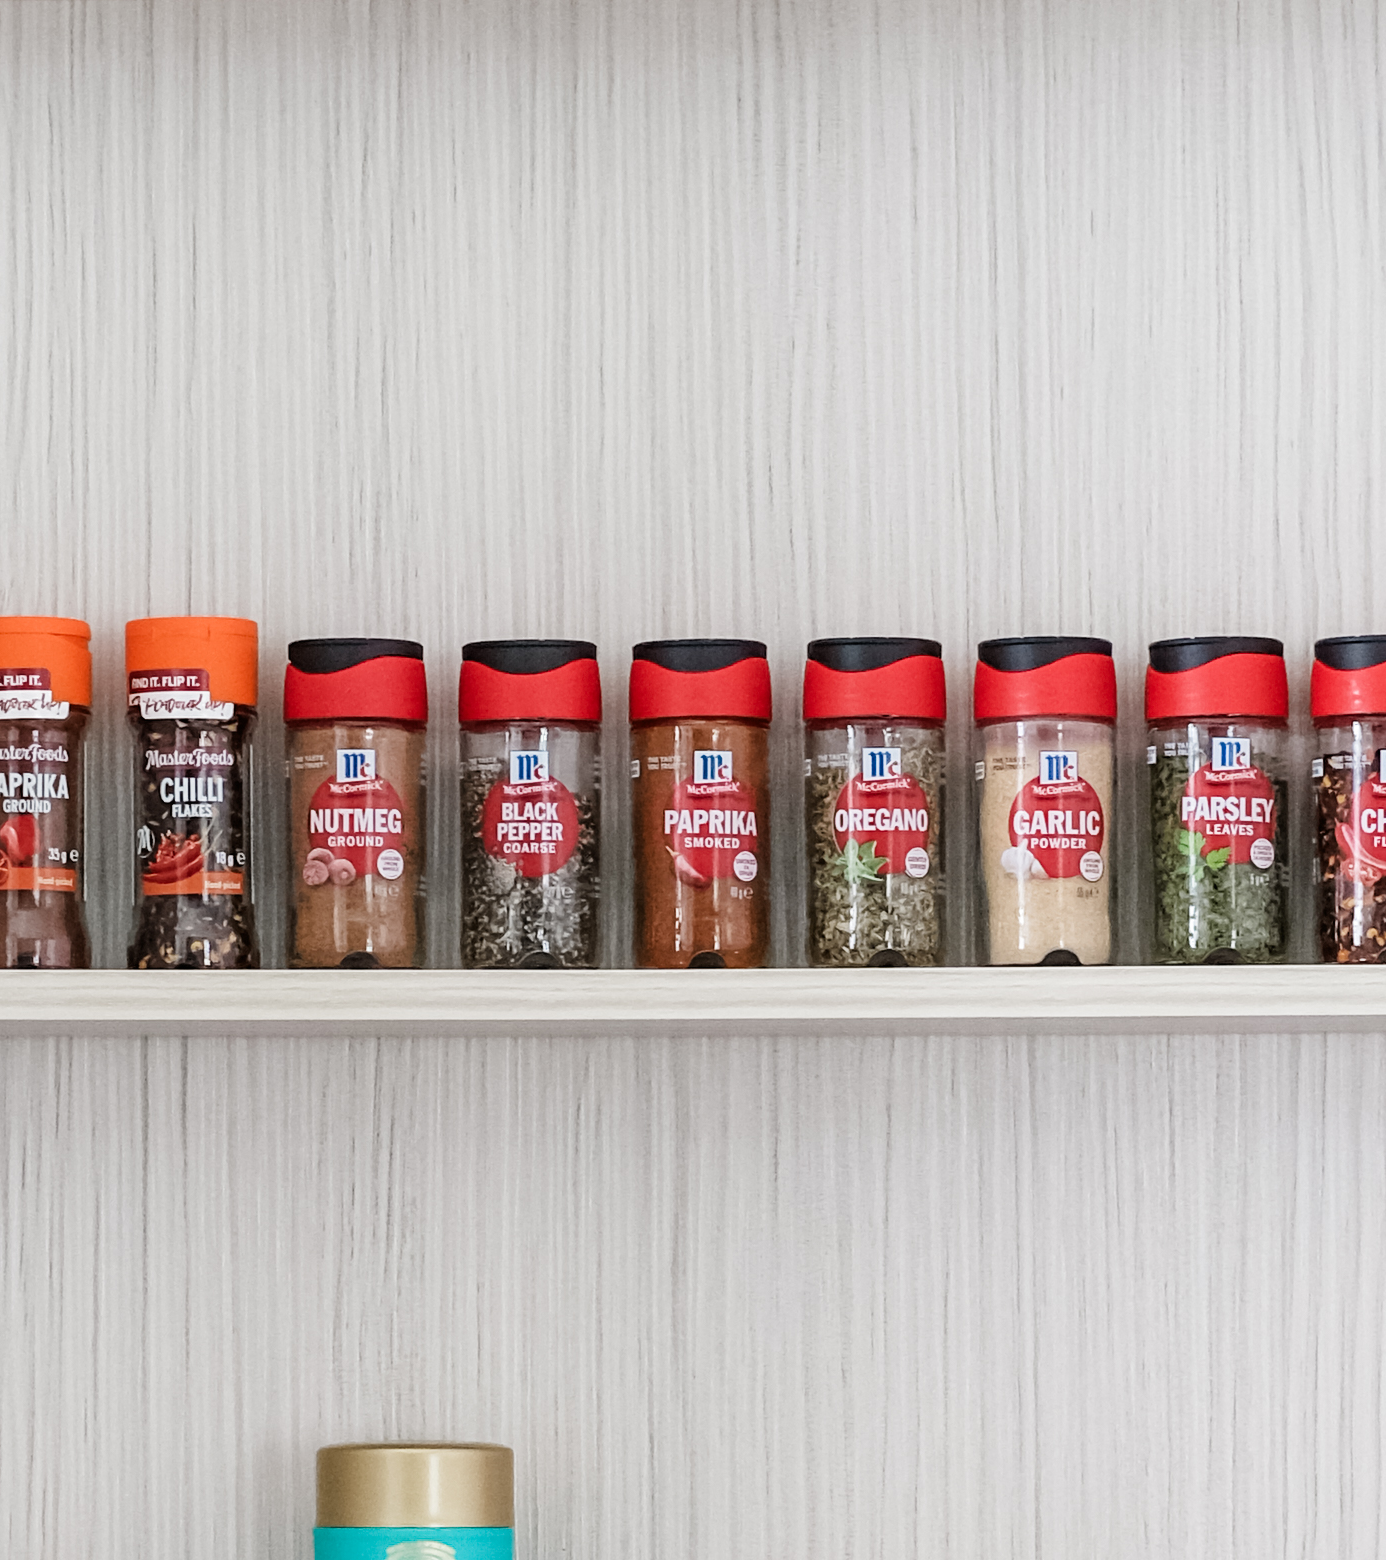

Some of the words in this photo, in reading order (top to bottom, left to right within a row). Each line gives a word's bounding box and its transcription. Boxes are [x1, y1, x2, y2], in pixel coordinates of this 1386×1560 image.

[145, 748, 234, 770] MasterFoods
[1203, 769, 1258, 783] McCormick
[159, 777, 224, 803] CHILLI
[328, 780, 383, 794] McCormick
[502, 781, 558, 796] McCormick
[686, 781, 740, 795] McCormick
[856, 777, 911, 792] McCormick
[1031, 782, 1086, 796] McCormick
[3, 800, 51, 814] GROUND
[172, 804, 213, 818] FLAKES
[501, 802, 558, 821] BLACK
[1182, 796, 1274, 824] PARSLEY
[310, 808, 402, 834] NUTMEG
[664, 810, 758, 837] PAPRIKA
[835, 808, 928, 833] OREGANO
[1013, 810, 1100, 836] GARLIC
[497, 821, 564, 841] PEPPER
[1206, 824, 1254, 837] LEAVES
[327, 835, 384, 847] GROUND
[503, 842, 556, 854] COARSE
[684, 837, 740, 849] SMOKED
[1030, 838, 1087, 849] POWDER
